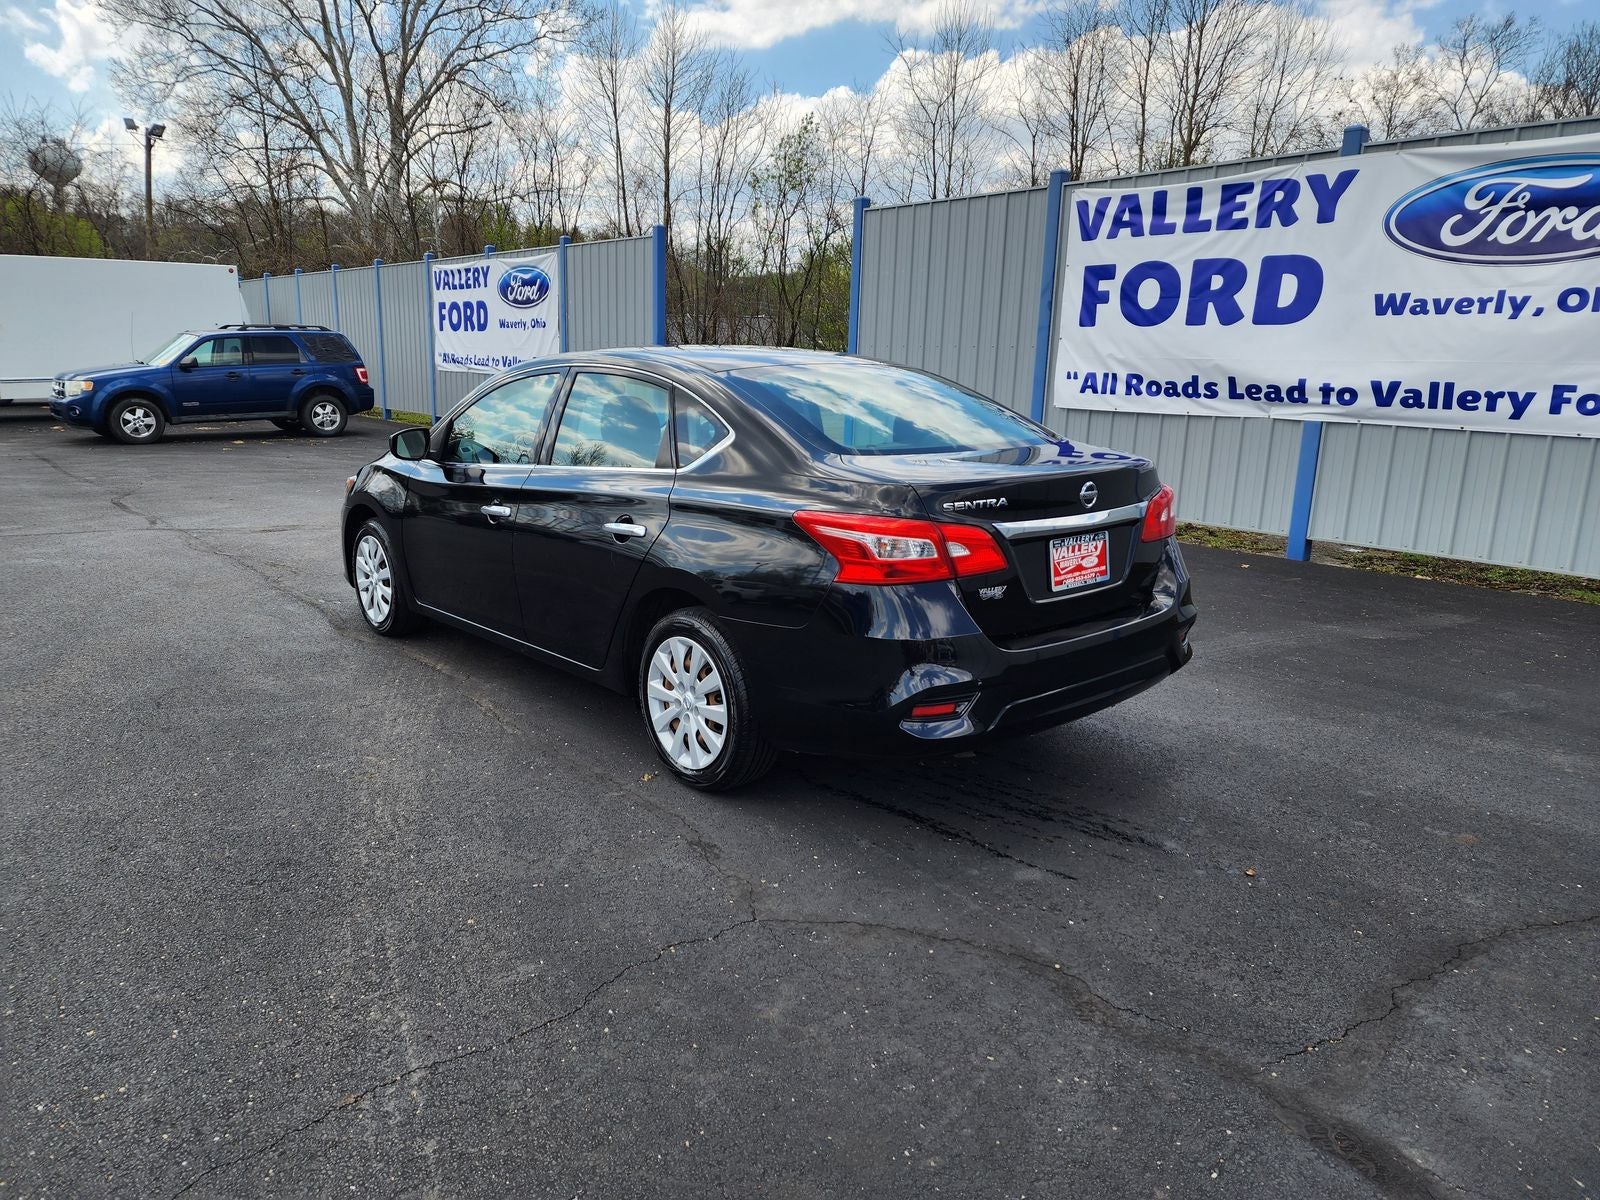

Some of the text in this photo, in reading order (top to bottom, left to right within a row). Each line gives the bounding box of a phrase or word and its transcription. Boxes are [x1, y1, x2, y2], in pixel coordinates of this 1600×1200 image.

[1076, 169, 1360, 241] VALLERY
[434, 265, 490, 291] VALLERY
[507, 272, 541, 301] Ford
[1079, 254, 1324, 327] FORD
[438, 300, 488, 332] FORD
[1374, 289, 1545, 320] Waverly,
[499, 317, 546, 331] Waverly, Ohio
[450, 353, 472, 365] Roads
[473, 354, 490, 366] Lead
[491, 356, 500, 367] to
[1125, 372, 1219, 400] Roads
[1227, 376, 1308, 404] Lead
[1319, 382, 1358, 406] to
[1370, 380, 1537, 420] Vallery
[942, 497, 1009, 512] SENTRA
[1053, 540, 1104, 560] VALLERY
[1064, 533, 1095, 546] VALLERY
